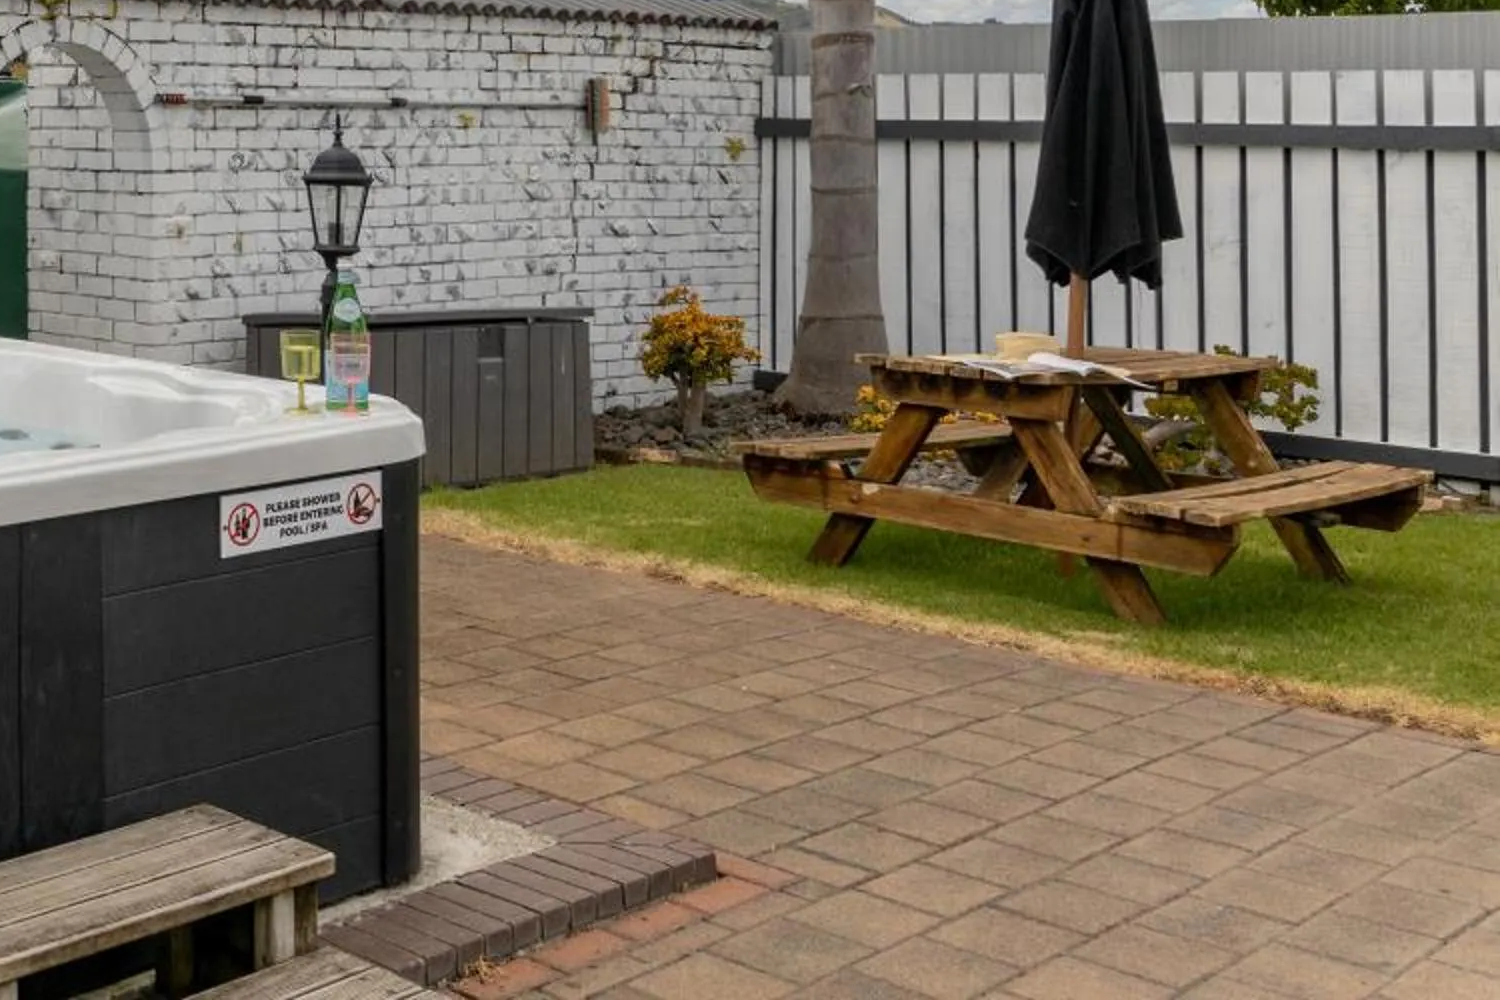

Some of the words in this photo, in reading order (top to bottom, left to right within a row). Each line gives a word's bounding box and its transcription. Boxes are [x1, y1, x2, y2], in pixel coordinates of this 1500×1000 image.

[265, 499, 300, 513] PLEASE
[302, 491, 341, 508] SHOWER
[263, 512, 298, 527] BEFORE
[300, 504, 344, 521] ENTERING
